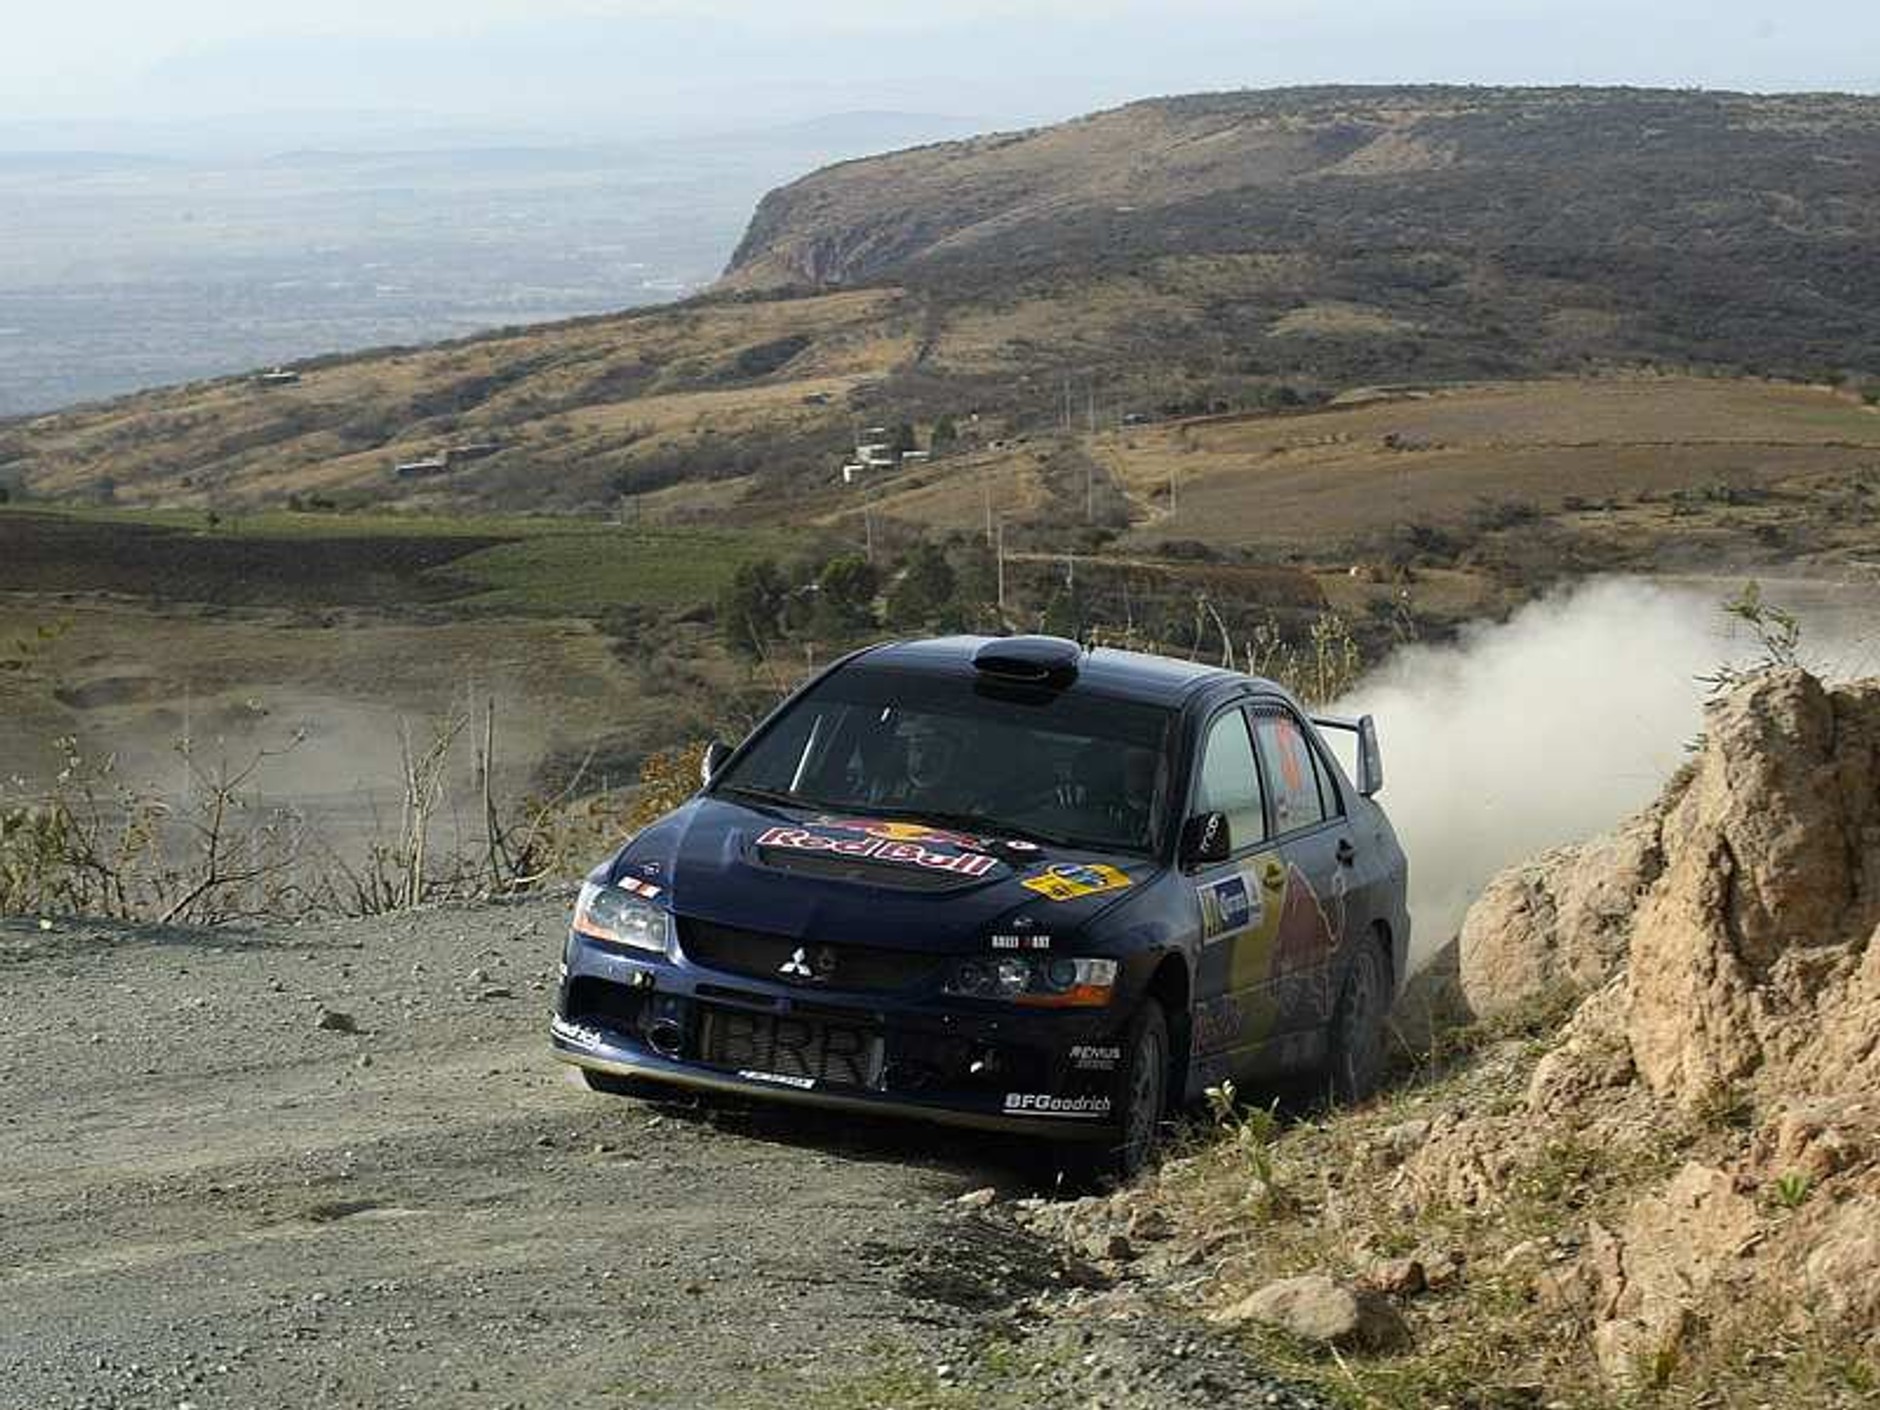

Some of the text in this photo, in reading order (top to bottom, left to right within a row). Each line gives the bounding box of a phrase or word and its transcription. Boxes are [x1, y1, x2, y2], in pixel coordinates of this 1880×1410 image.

[756, 827, 998, 876] Red Bull
[1003, 1092, 1111, 1111] BFGoodrich
